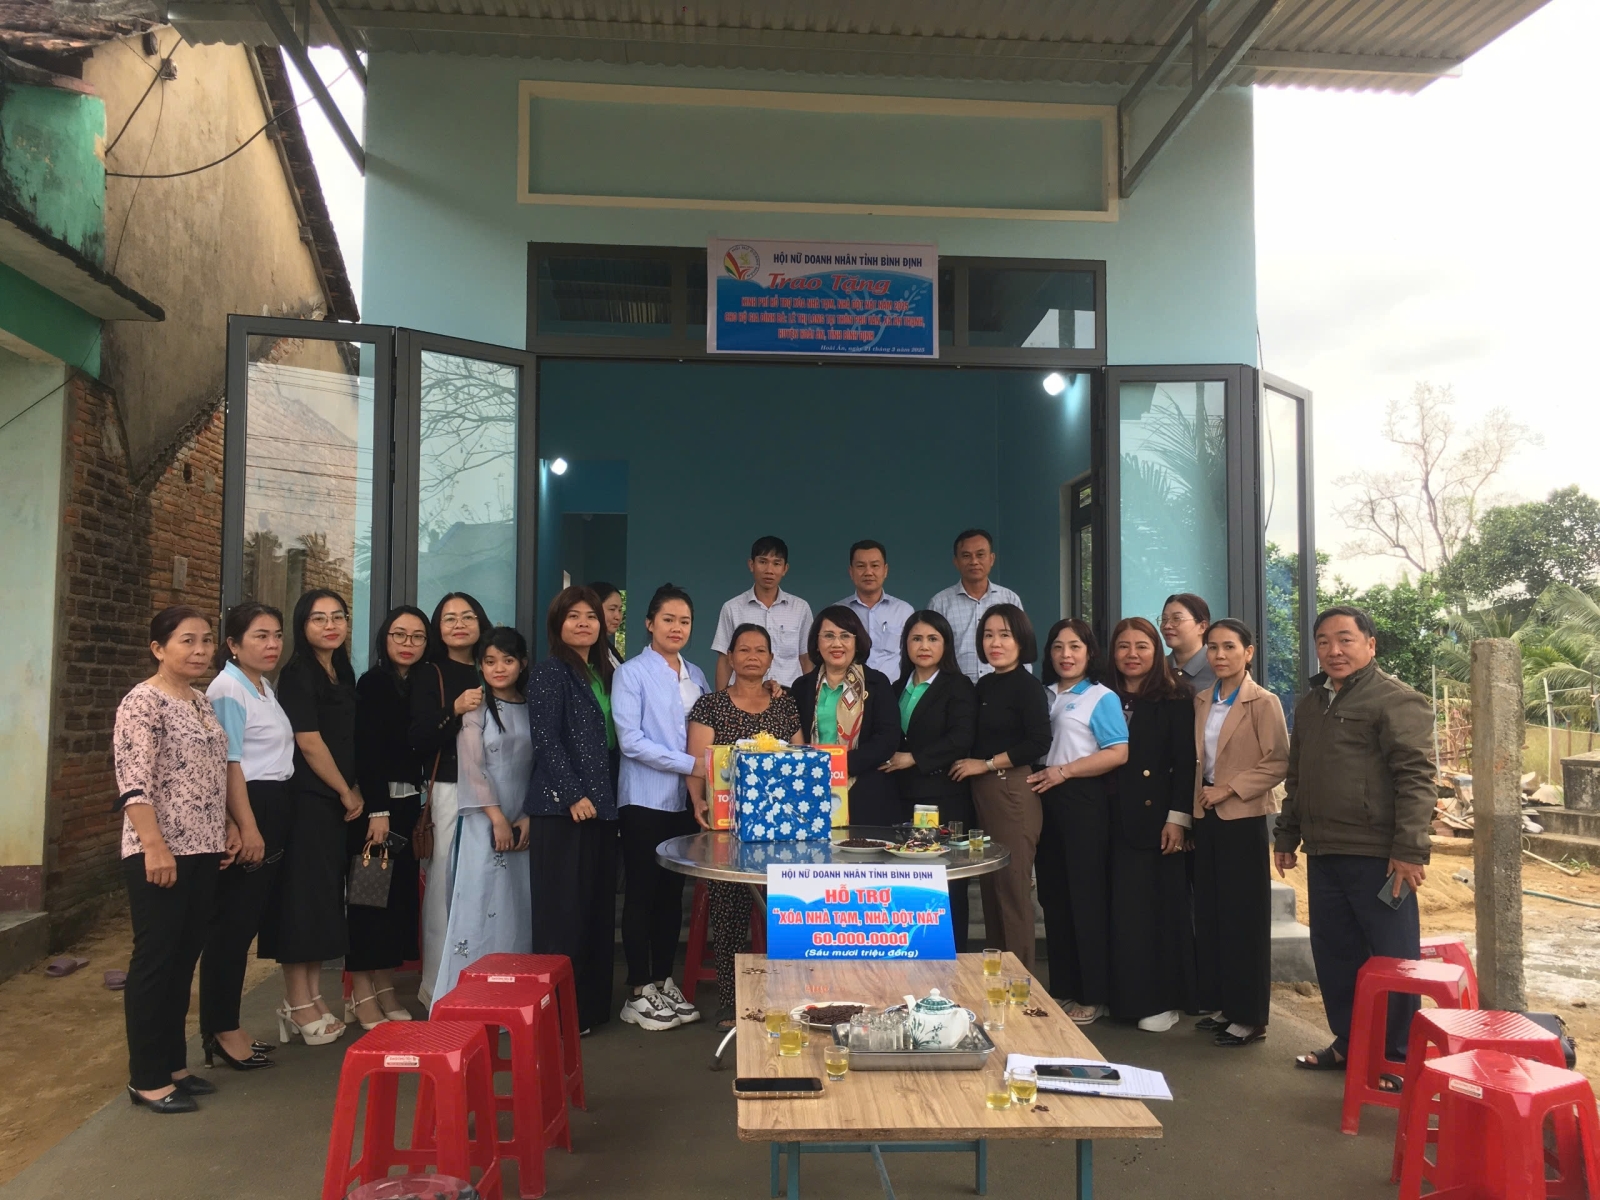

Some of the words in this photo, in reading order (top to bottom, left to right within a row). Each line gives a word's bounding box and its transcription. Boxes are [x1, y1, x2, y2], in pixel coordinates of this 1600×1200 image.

[774, 252, 787, 265] HỘI
[790, 252, 802, 263] NỮ
[805, 254, 832, 265] DOANH
[835, 253, 857, 266] NHÂN
[859, 253, 878, 266] TỈNH
[881, 255, 900, 267] BÌNH
[903, 257, 922, 269] ĐỊNH
[768, 272, 822, 290] Trao
[831, 274, 891, 295] Tặng
[741, 297, 757, 307] KINH
[758, 296, 769, 308] PHÍ
[770, 294, 779, 308] HỖ
[780, 297, 792, 309] TRỢ
[806, 297, 820, 309] NHÀ
[837, 298, 850, 310] NHÀ
[724, 312, 737, 323] CHO
[738, 310, 747, 325] HỘ
[748, 312, 760, 323] GIA
[760, 311, 776, 323] ĐÌNH
[788, 311, 796, 324] LÊ
[797, 313, 807, 325] THỊ
[836, 313, 853, 325] THÔN
[777, 327, 799, 340] HUYỆN
[781, 870, 796, 880] HỘI
[798, 869, 810, 879] NỮ
[813, 870, 841, 879] DOANH
[843, 869, 866, 879] NHÂN
[868, 869, 888, 879] TỈNH
[890, 870, 910, 880] BÌNH
[913, 871, 933, 881] ĐỊNH
[825, 884, 850, 903] HỖ
[855, 888, 891, 907] TRỢ
[806, 909, 830, 924] NHÀ
[833, 910, 862, 927] TẠM,
[865, 909, 889, 924] NHÀ
[892, 911, 913, 927] DỘT
[812, 932, 908, 945] 60.000.000đ
[804, 949, 829, 958] (Sáu
[832, 949, 858, 957] mươi
[861, 949, 885, 957] triệu
[887, 949, 919, 958] đồng)
